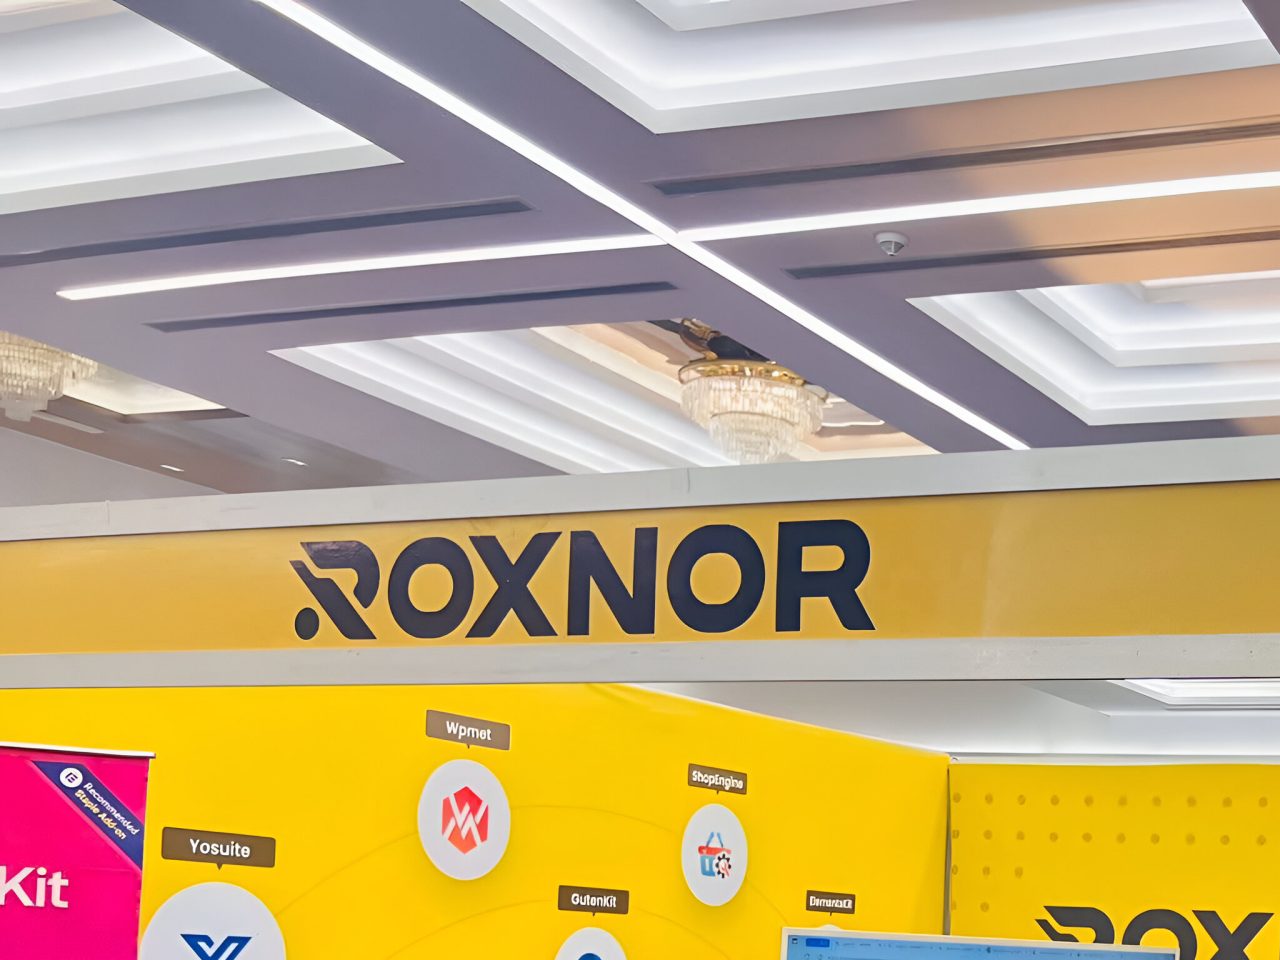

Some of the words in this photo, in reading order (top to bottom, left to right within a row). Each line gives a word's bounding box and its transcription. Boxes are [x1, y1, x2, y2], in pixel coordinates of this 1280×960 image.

[289, 519, 876, 640] ROXNOR
[445, 720, 492, 740] Wpmet
[692, 770, 744, 791] ShopEngine
[83, 782, 141, 836] Recommended
[189, 838, 251, 858] Yosuite
[0, 865, 69, 908] Kit
